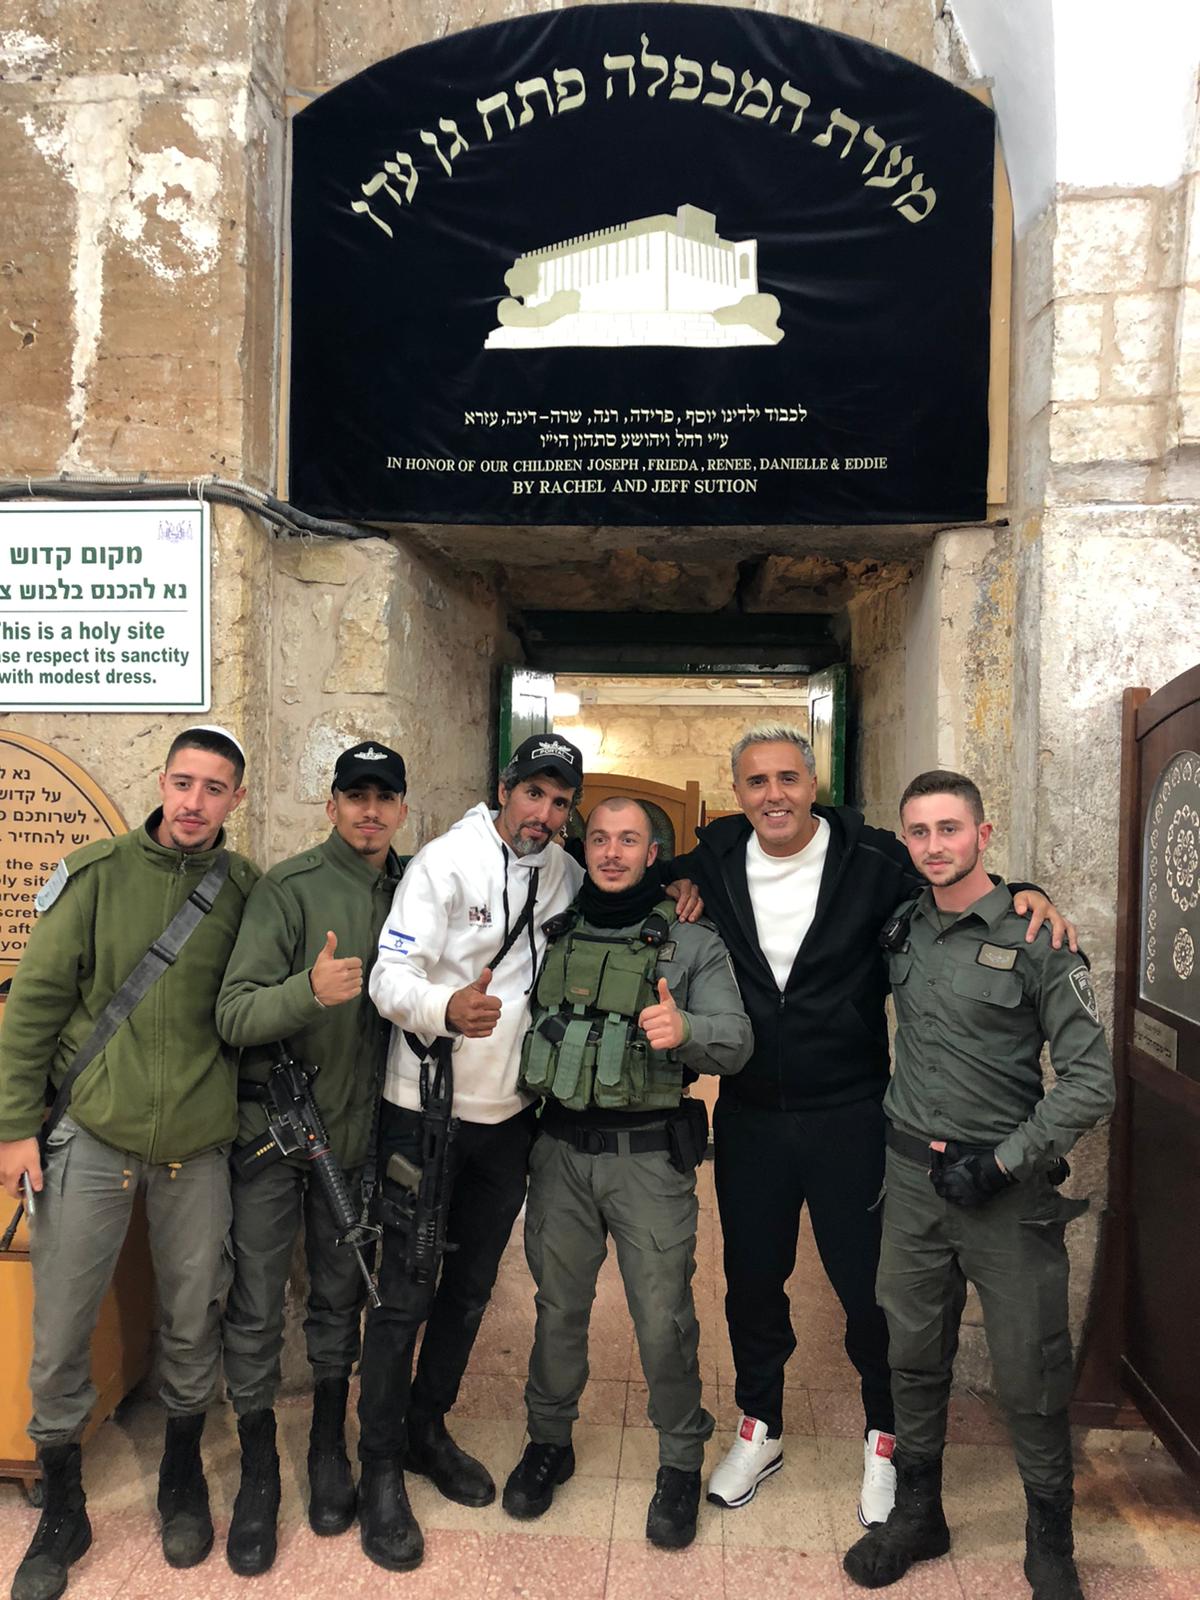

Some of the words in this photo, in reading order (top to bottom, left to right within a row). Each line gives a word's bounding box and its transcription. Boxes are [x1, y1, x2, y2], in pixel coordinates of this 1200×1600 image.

[602, 32, 812, 134] המכפלה
[476, 67, 586, 142] פתח
[419, 116, 470, 178] גן
[812, 107, 937, 224] מערת
[350, 150, 419, 239] עדן
[464, 411, 499, 428] עזרא
[720, 403, 761, 423] ילדינו
[764, 403, 808, 422] לכבוד
[620, 433, 671, 449] ויהושע
[674, 428, 703, 447] רחל
[386, 456, 403, 469] IN
[405, 457, 456, 472] HONOR
[457, 459, 477, 472] OF
[480, 459, 509, 473] OUR
[512, 459, 583, 473] CHILDREN
[706, 458, 758, 472] RENEE,
[759, 457, 829, 471] DANIELLE
[830, 457, 840, 471] &
[844, 456, 888, 471] EDDIE
[512, 480, 535, 495] BY
[539, 479, 607, 494] RACHEL
[611, 478, 648, 493] AND
[650, 479, 691, 494] JEFF
[9, 546, 72, 571] קדוש
[81, 545, 143, 571] מקום
[19, 577, 84, 600] בלבוש
[90, 577, 156, 600] להכנס
[163, 583, 187, 600] נא
[0, 621, 31, 640] his
[38, 621, 55, 640] is
[60, 625, 73, 640] a
[79, 620, 121, 645] holy
[127, 620, 165, 640] site
[26, 648, 90, 667] respect
[95, 647, 116, 663] its
[121, 647, 190, 667] sanctity
[0, 668, 34, 684] with
[39, 668, 100, 684] modest
[105, 668, 157, 684] dress.
[12, 768, 31, 781] נא
[41, 787, 62, 803] על
[13, 809, 87, 824] לשרותכם
[8, 829, 65, 845] להחזיר
[71, 833, 90, 845] יש
[6, 858, 33, 871] the
